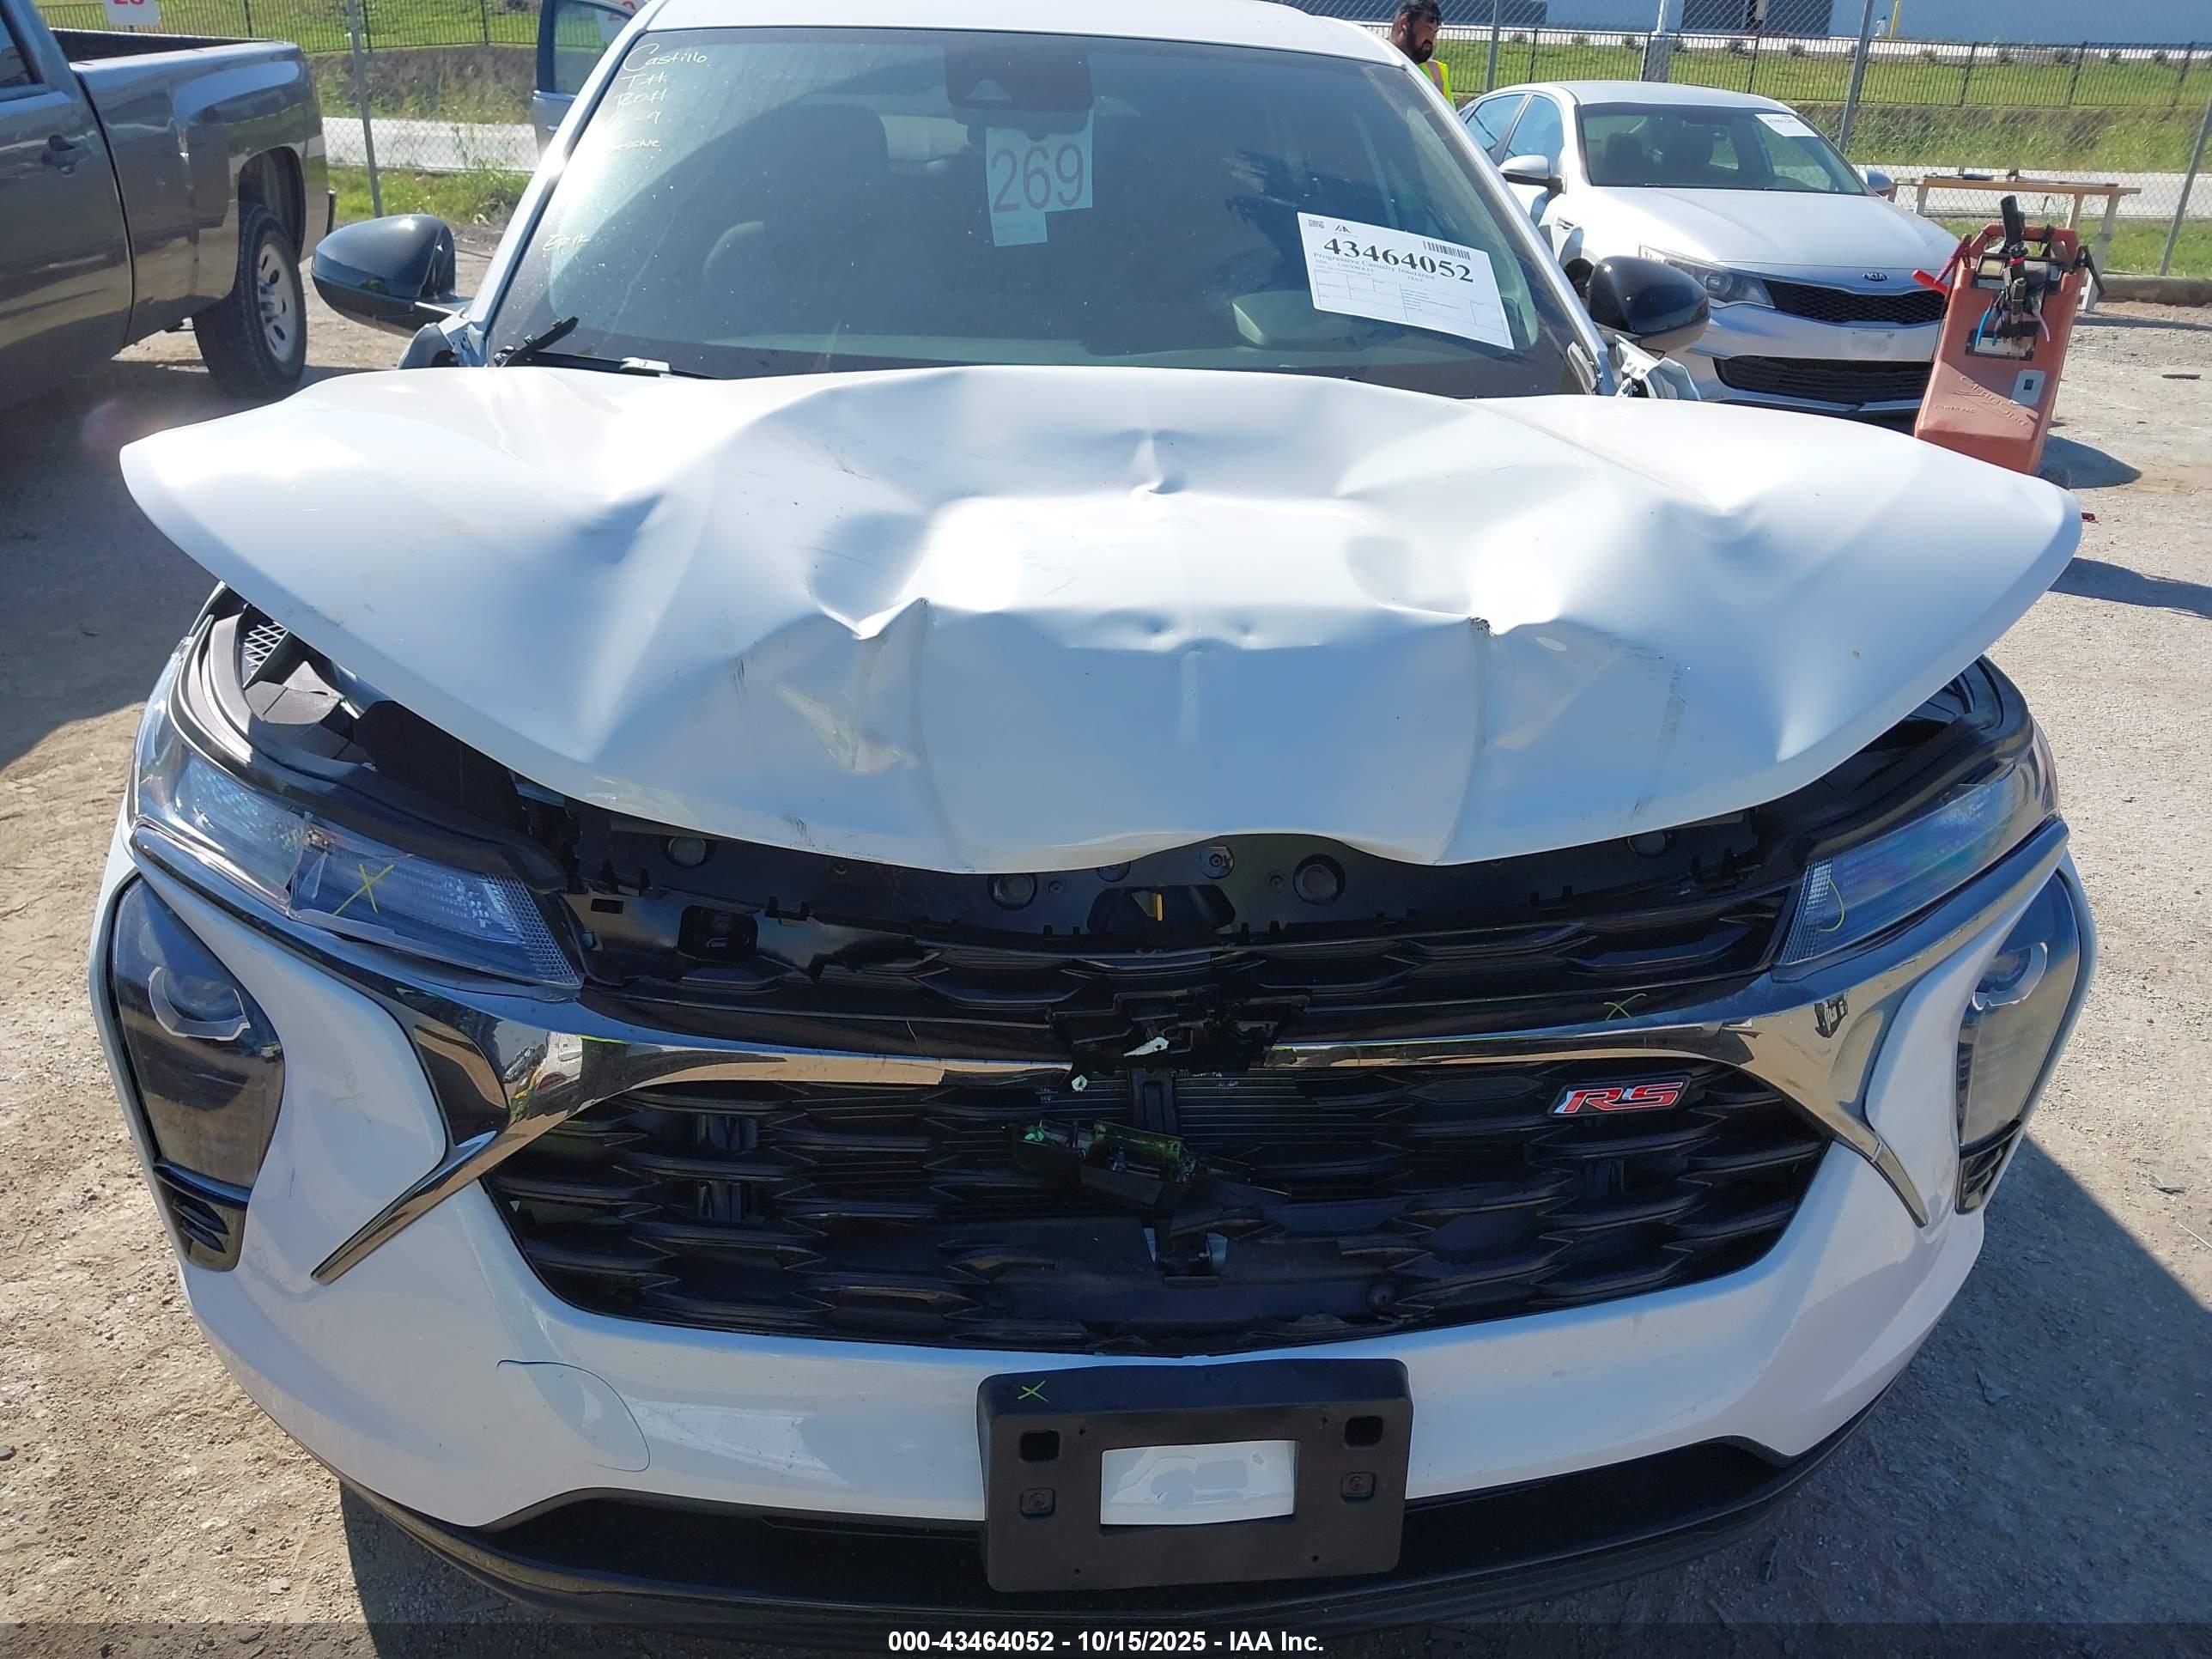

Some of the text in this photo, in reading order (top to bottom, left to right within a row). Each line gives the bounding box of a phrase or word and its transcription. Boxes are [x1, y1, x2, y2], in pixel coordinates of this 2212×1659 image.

[623, 43, 708, 71] Castillo
[990, 142, 1085, 214] 269
[1323, 237, 1474, 283] 43464052
[1866, 272, 1887, 281] KIA
[1553, 1081, 1684, 1114] RS
